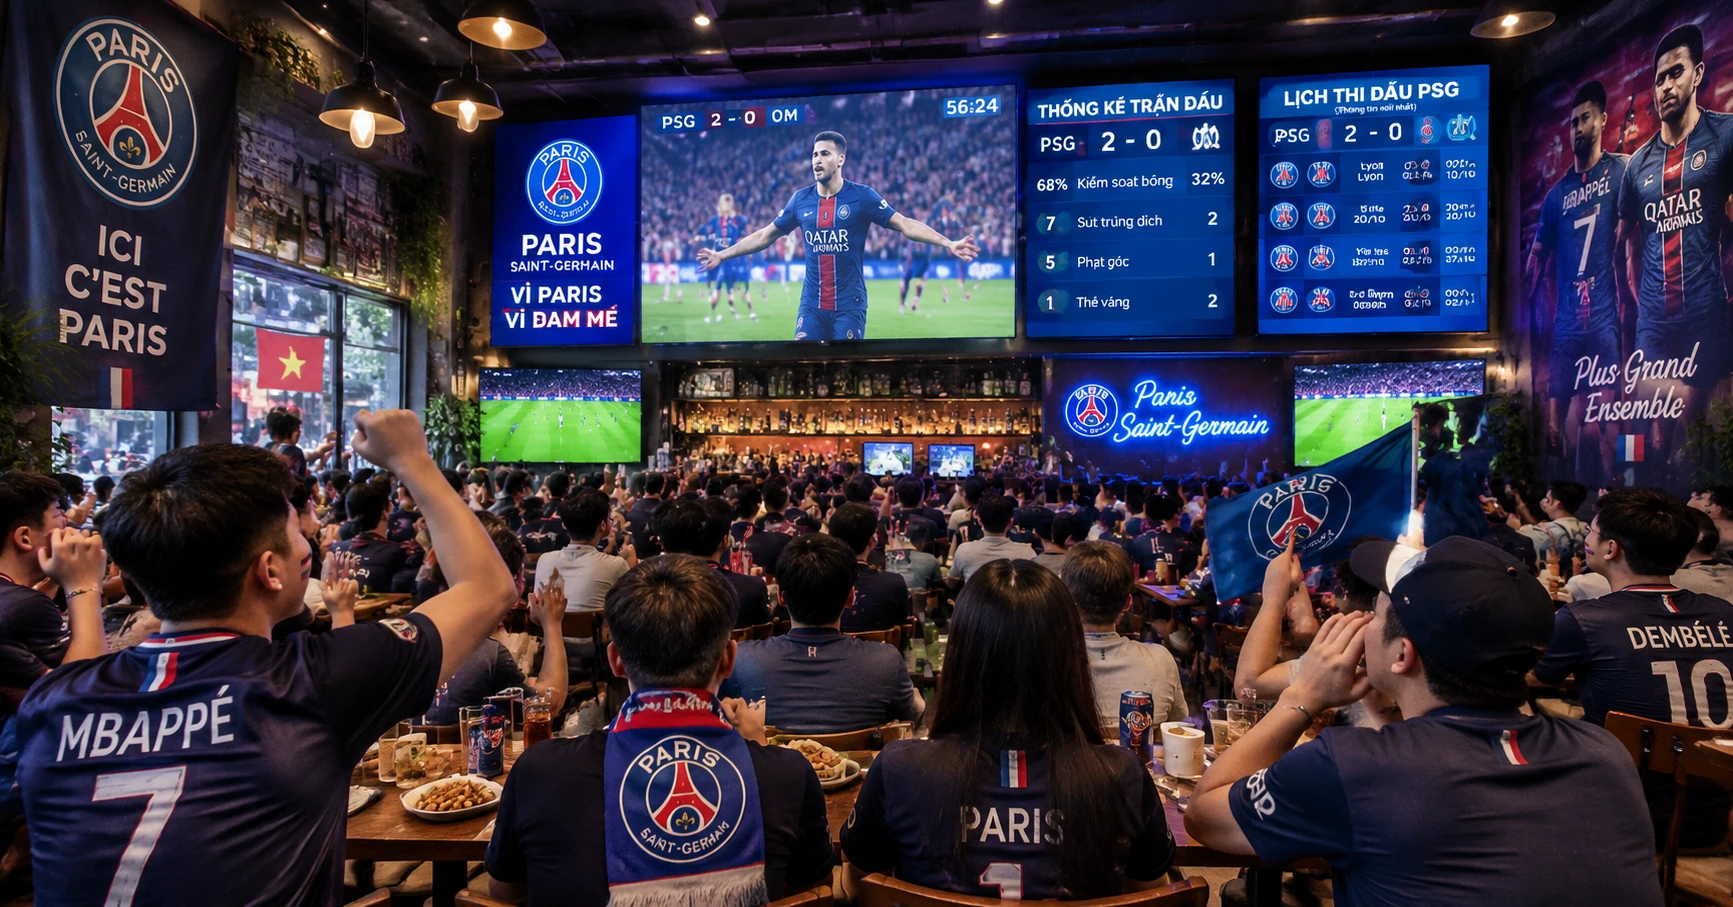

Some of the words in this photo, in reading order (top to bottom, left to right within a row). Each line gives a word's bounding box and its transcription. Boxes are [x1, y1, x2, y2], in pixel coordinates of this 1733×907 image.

[85, 28, 179, 93] PARIS
[946, 97, 999, 115] 56:24
[1284, 89, 1328, 109] LỊCH
[1333, 86, 1365, 103] THI
[1418, 81, 1459, 99] PSG
[662, 114, 696, 129] PSG
[711, 113, 722, 127] 2
[744, 110, 756, 124] 0
[771, 108, 798, 123] OM
[1344, 124, 1356, 143] 2
[1389, 122, 1402, 141] 0
[539, 144, 590, 166] PARIS
[1040, 136, 1076, 152] PSG
[1101, 131, 1116, 151] 2
[1146, 129, 1161, 150] 0
[1036, 178, 1068, 192] 68%
[1191, 172, 1225, 186] 32%
[1357, 172, 1384, 182] Lyon
[1644, 188, 1701, 223] QATAR
[1046, 216, 1056, 231] 7
[1208, 211, 1218, 226] 2
[98, 224, 142, 267] ICI
[522, 232, 602, 256] PARIS
[804, 229, 848, 246] QATAR
[1574, 213, 1597, 276] 7
[1045, 255, 1055, 270] 5
[1107, 255, 1129, 270] góc
[1208, 252, 1216, 266] 1
[65, 263, 167, 314] C'EST
[538, 285, 602, 303] PARIS
[1046, 295, 1053, 310] 1
[1207, 294, 1218, 308] 2
[59, 308, 167, 356] PARIS
[1574, 355, 1619, 390] Plus
[1624, 341, 1700, 394] Grand
[1584, 385, 1685, 423] Ensemble
[1113, 410, 1270, 445] Saint-Germain
[1627, 620, 1733, 649] DEMBÉLÉ
[1650, 659, 1733, 730] 10
[56, 684, 234, 762] MBAPPÉ
[638, 740, 720, 774] PARIS
[91, 765, 187, 907] 7
[960, 806, 1064, 845] PARIS
